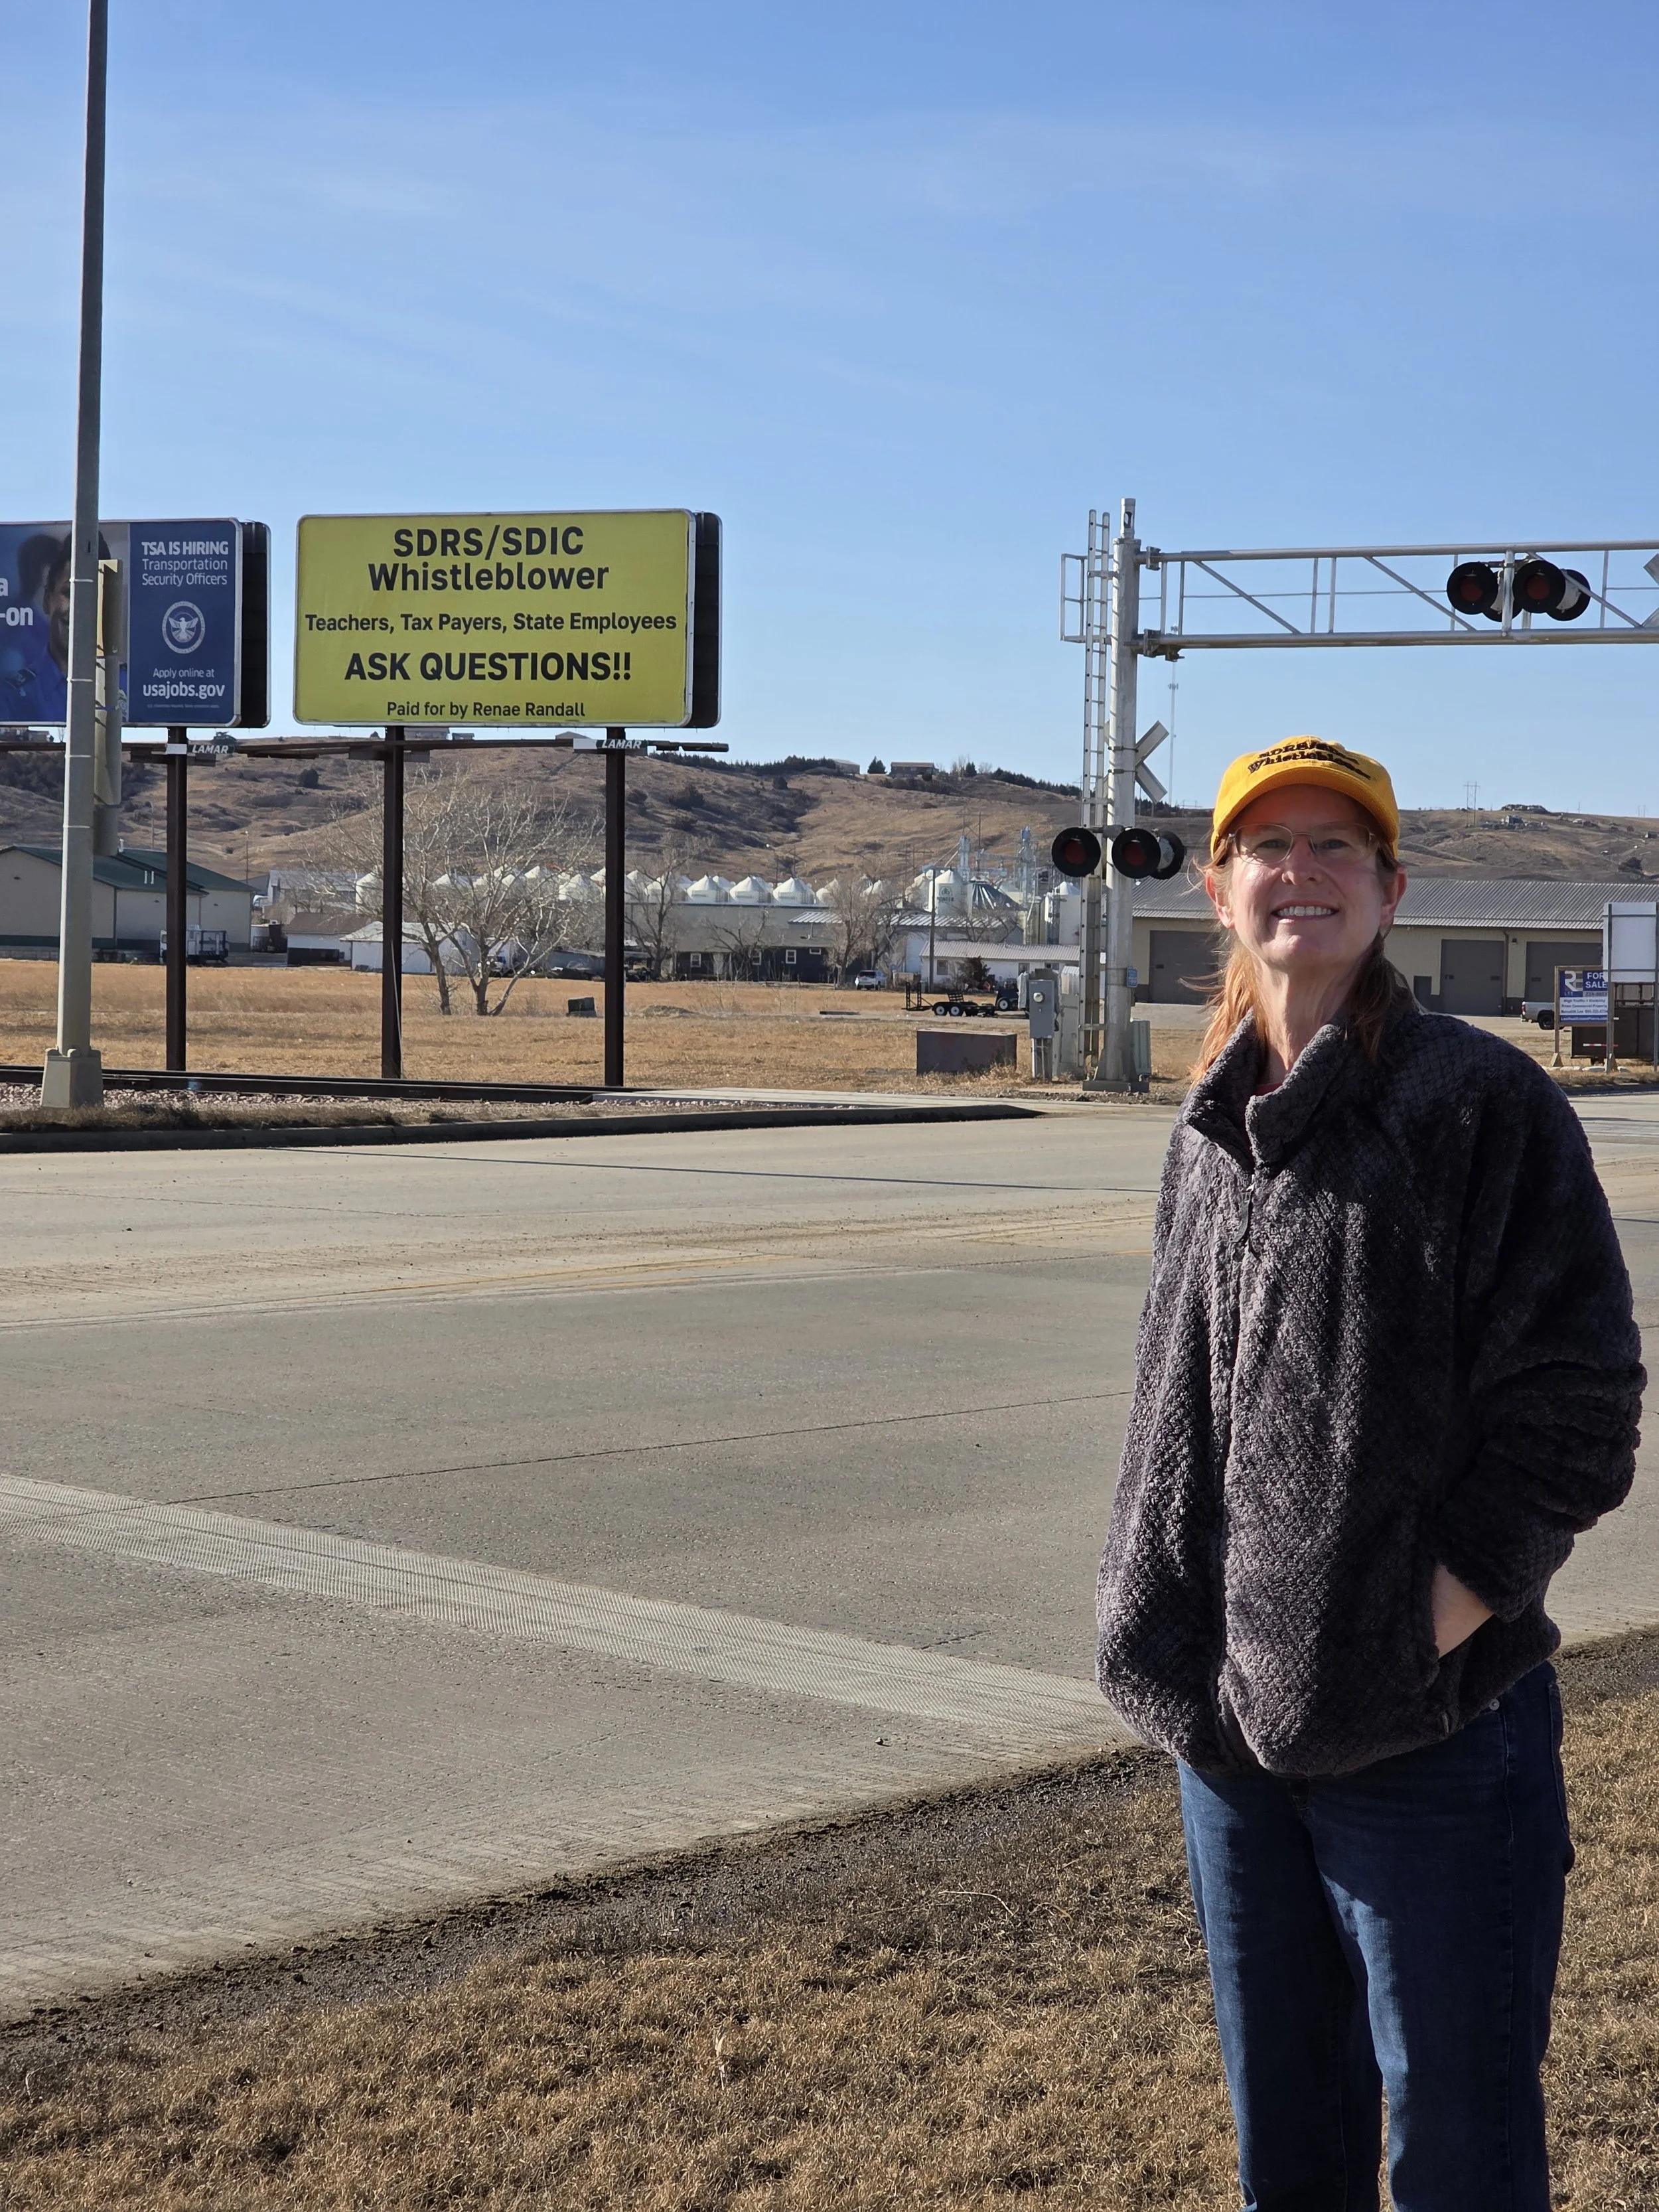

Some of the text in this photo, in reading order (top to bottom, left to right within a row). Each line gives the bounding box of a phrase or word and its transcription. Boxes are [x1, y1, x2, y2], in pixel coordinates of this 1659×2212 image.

[141, 541, 228, 555] TSA IS HIRING
[394, 525, 583, 560] SDRS/SDIC
[142, 557, 227, 572] Transportation
[142, 572, 227, 587] Security Officers
[368, 562, 609, 591] Whistleblower
[305, 613, 677, 634] Teachers, Tax Payers, State Employees
[153, 668, 214, 679] Apply online at
[344, 652, 631, 681] ASK QUESTIONS!!
[143, 681, 225, 699] usajobs.gov
[388, 701, 585, 718] Paid for by Renae Randall
[192, 744, 229, 755] LAMAR
[601, 739, 642, 749] LAMAR
